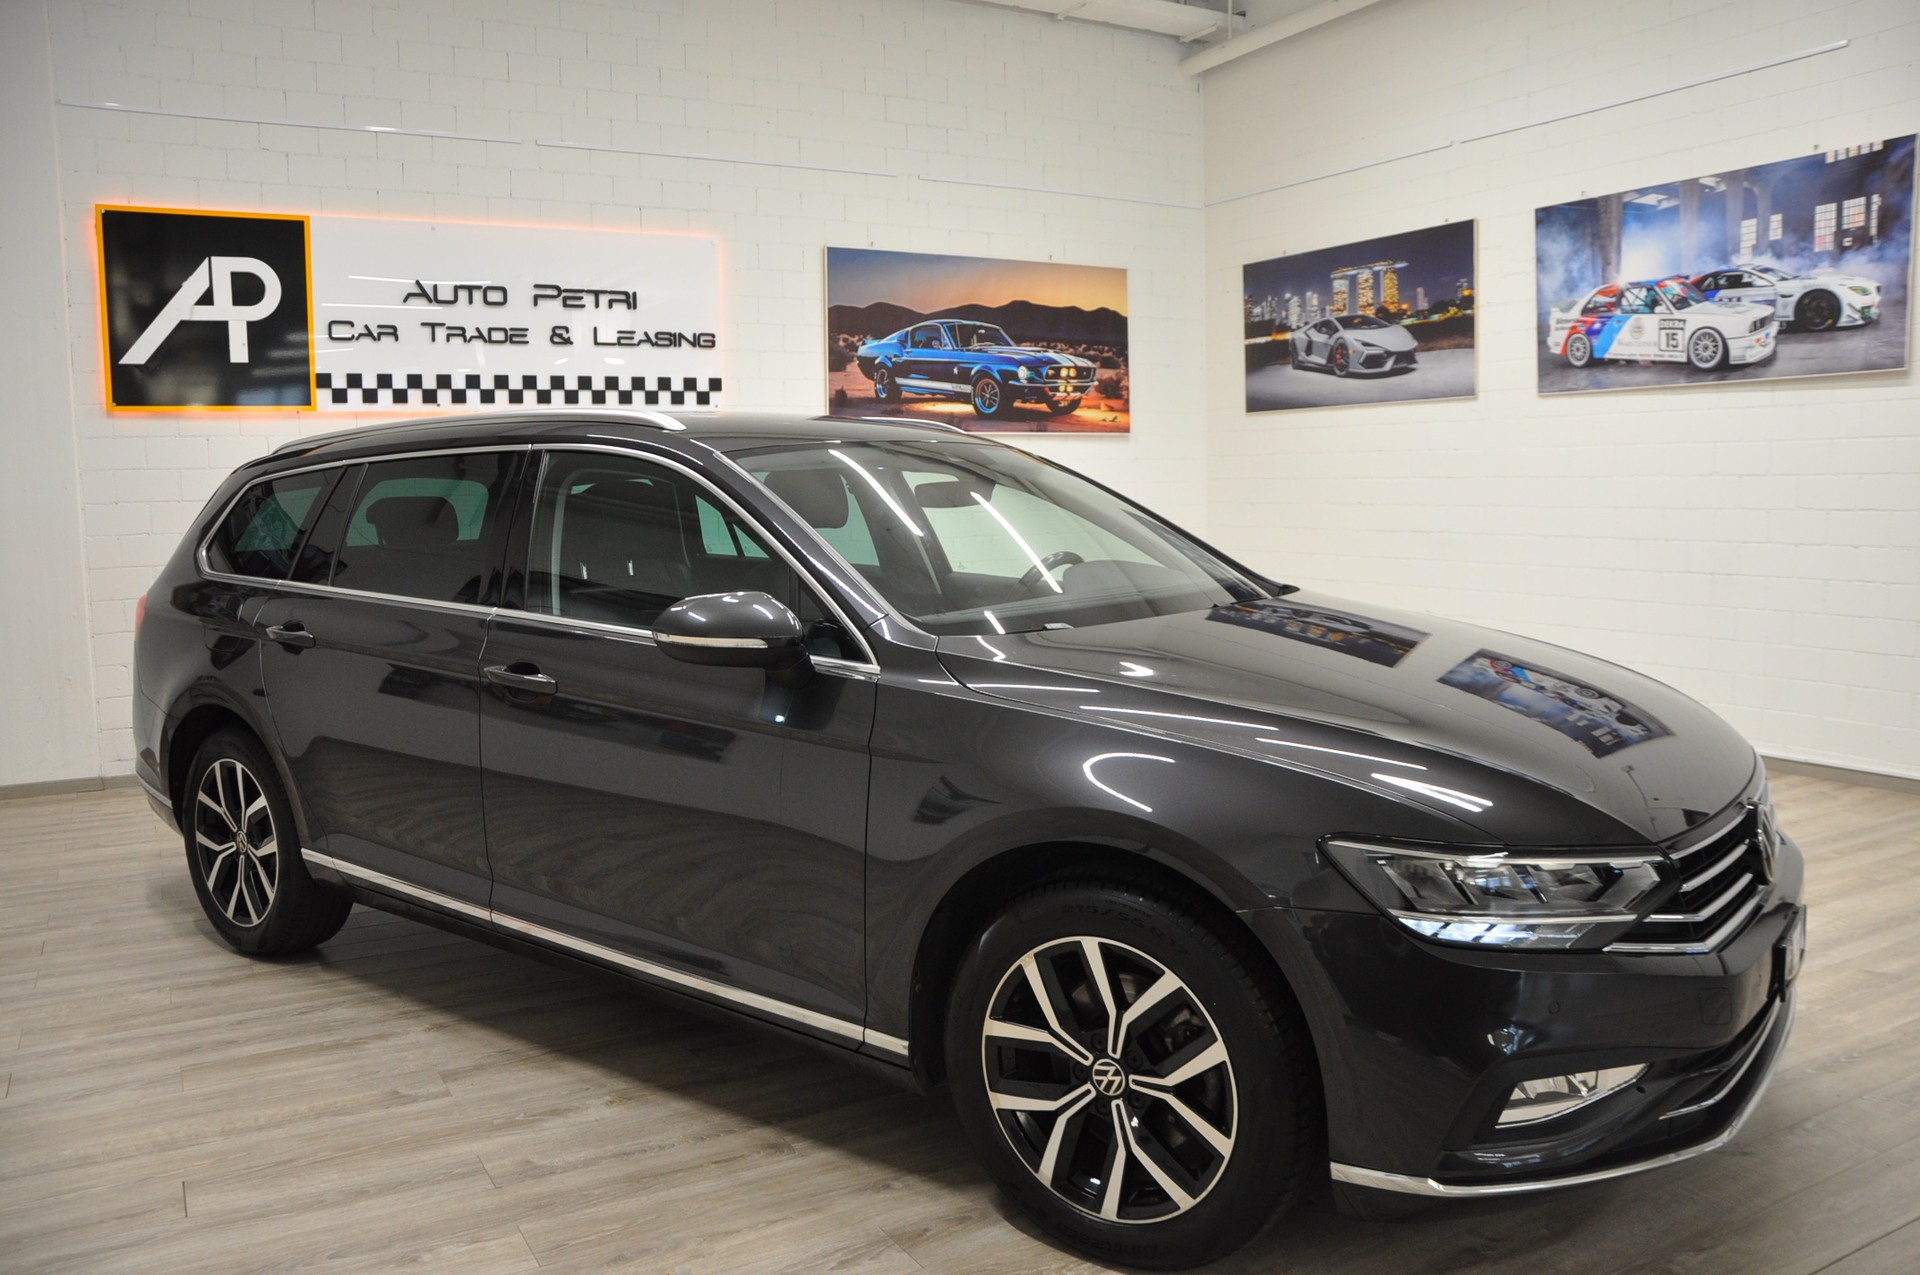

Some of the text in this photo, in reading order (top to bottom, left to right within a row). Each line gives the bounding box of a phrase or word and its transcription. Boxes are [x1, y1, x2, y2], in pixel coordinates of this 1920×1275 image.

[402, 279, 638, 311] AUTO PETRI
[327, 319, 716, 349] CAR TRADE & LEASING
[1665, 332, 1680, 349] 15
